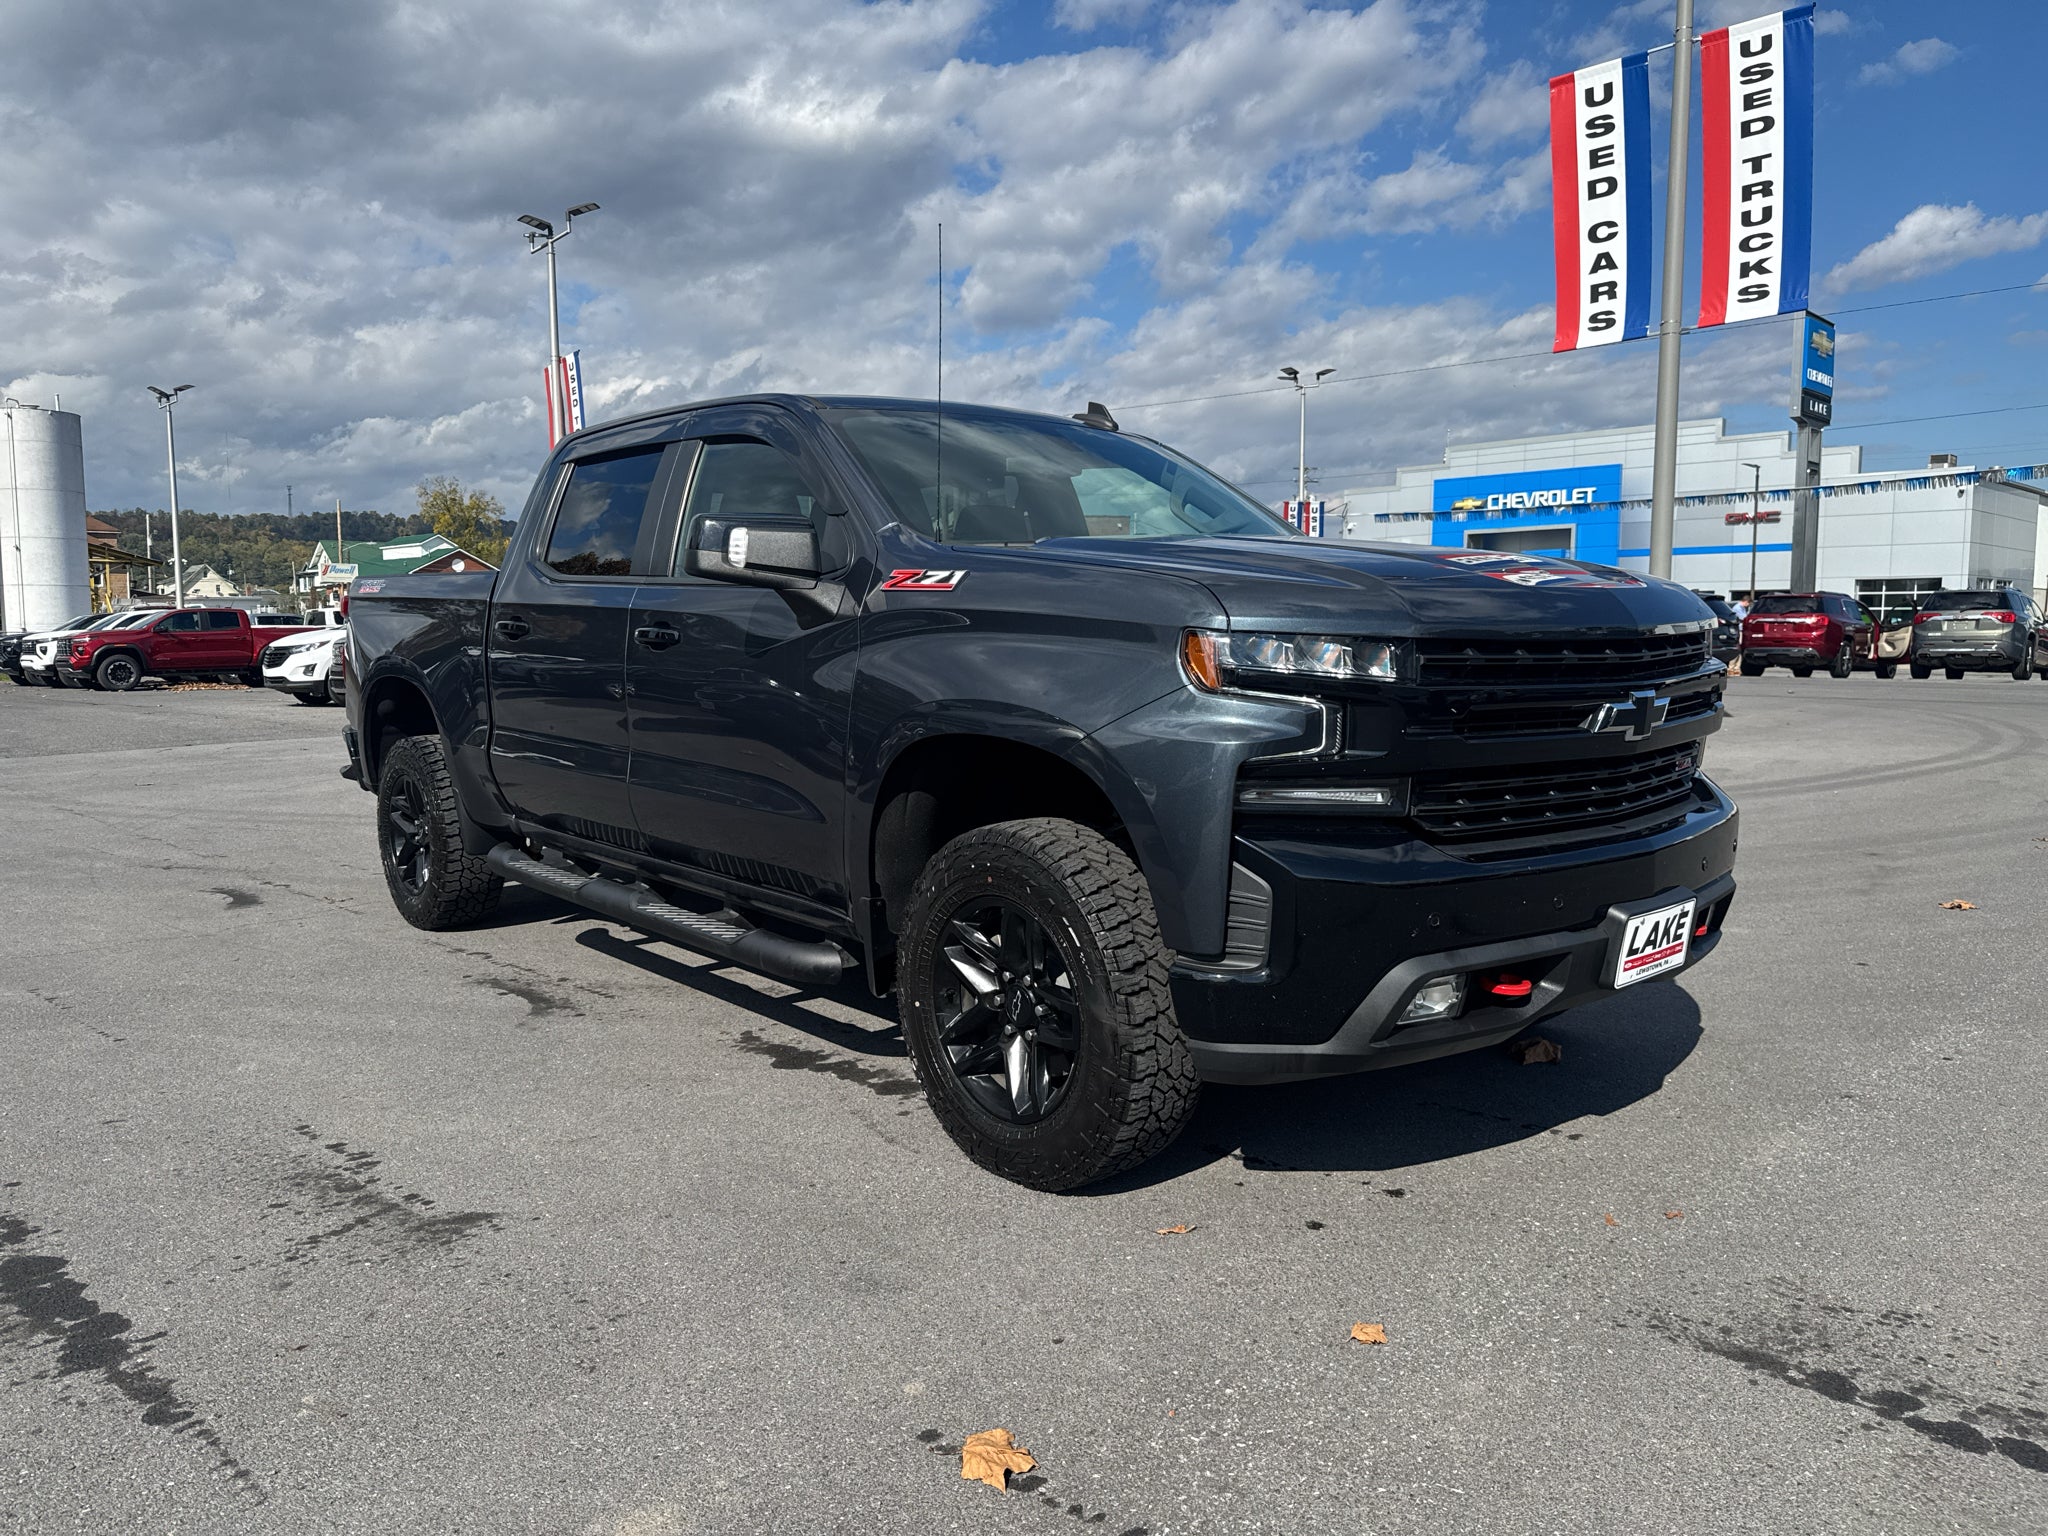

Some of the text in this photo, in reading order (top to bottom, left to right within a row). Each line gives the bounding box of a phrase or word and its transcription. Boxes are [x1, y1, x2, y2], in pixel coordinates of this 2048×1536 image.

[1737, 34, 1775, 304] USED TRUCKS
[1585, 82, 1619, 332] USED CARS
[568, 362, 579, 408] USED
[1809, 399, 1828, 416] LAKE
[1487, 487, 1597, 511] CHEVROLET
[1725, 511, 1781, 526] GMC
[329, 565, 356, 574] Powell
[880, 569, 968, 591] Z71
[1625, 910, 1690, 958] LAKE
